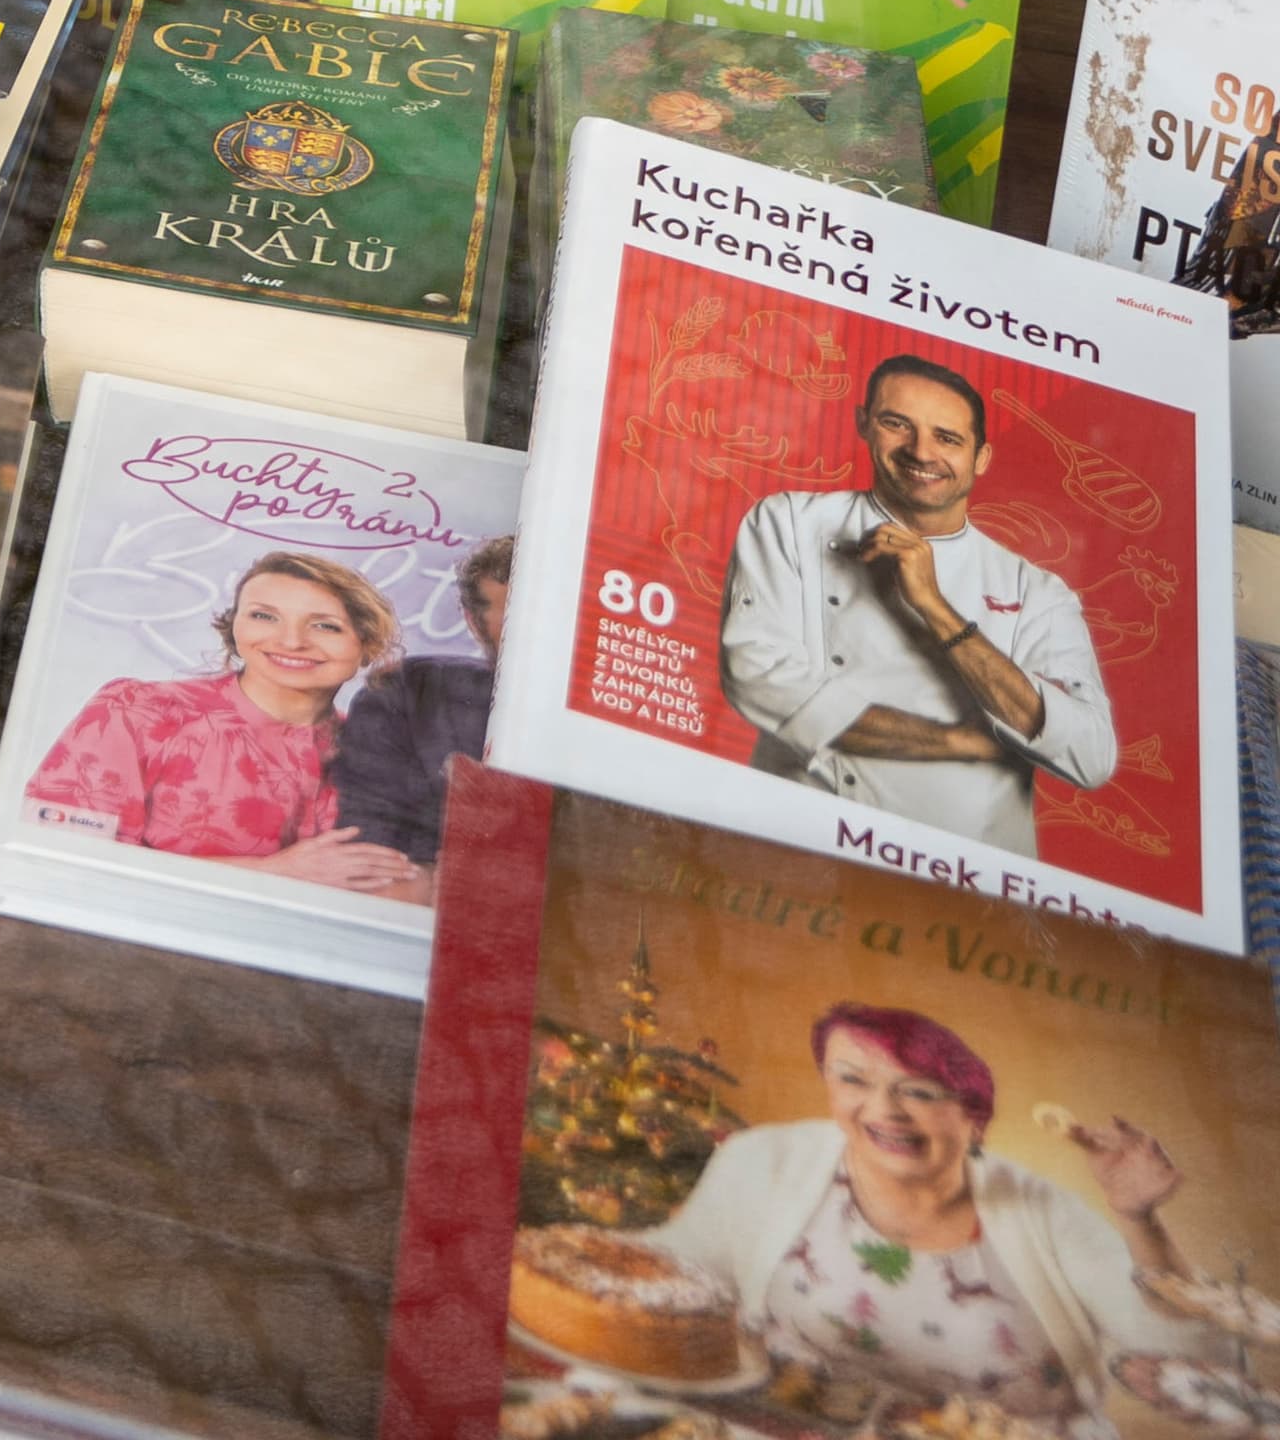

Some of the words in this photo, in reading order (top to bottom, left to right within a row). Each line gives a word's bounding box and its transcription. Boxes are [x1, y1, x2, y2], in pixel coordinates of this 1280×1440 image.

[222, 8, 427, 52] REBECCA
[153, 21, 476, 97] GABLÉ
[227, 193, 337, 229] HRA
[636, 158, 876, 255] Kuchařka
[153, 211, 397, 273] KRÁLŮ
[241, 272, 285, 289] IKAR
[630, 198, 871, 298] kořeněná
[889, 273, 1103, 366] životem
[1157, 306, 1195, 328] fronta
[121, 434, 351, 519] Buchty
[598, 569, 675, 627] 80
[597, 635, 682, 673] RECEPTŮ
[598, 618, 696, 660] SKVĚLÝCH
[593, 670, 705, 720] ZAHRÁDEK,
[595, 652, 608, 667] Z
[612, 658, 697, 698] DVORKŮ,
[591, 688, 633, 712] VOD
[637, 704, 651, 719] A
[656, 709, 702, 734] LESŮ
[837, 816, 981, 894] Marek
